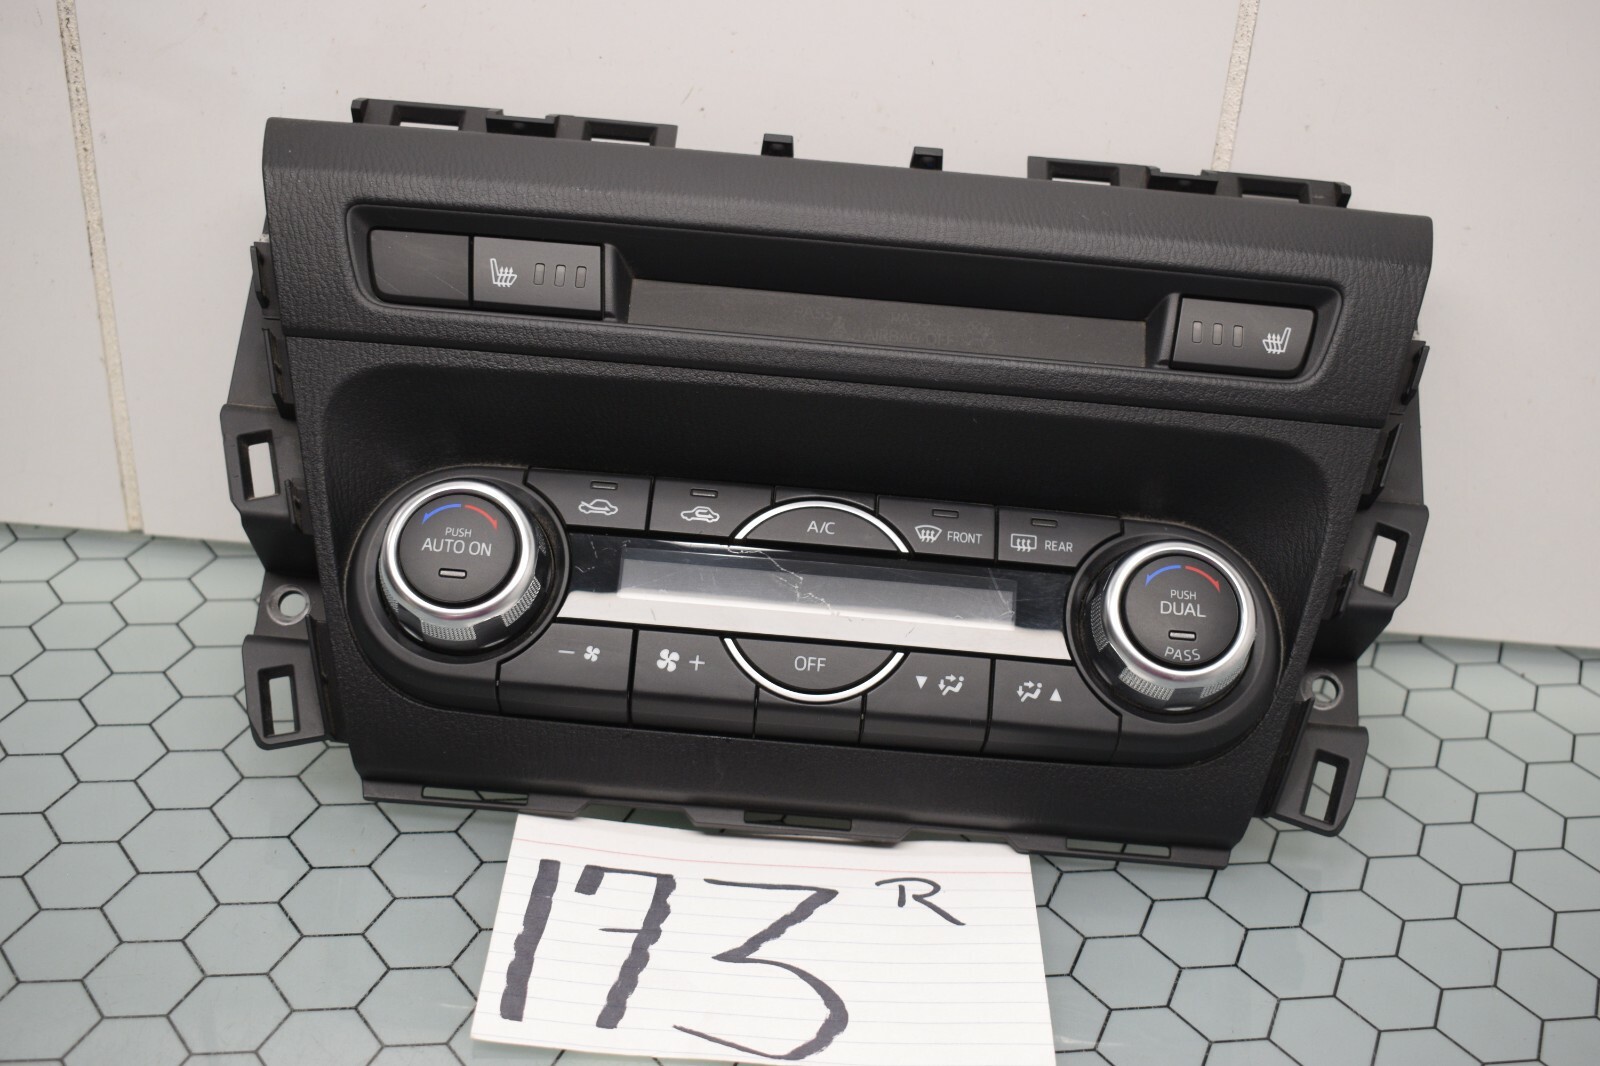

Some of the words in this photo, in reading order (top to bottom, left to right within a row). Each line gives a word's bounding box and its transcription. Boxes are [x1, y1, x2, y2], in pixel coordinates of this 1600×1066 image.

[444, 526, 472, 538] PUSH
[806, 520, 836, 536] A/C
[946, 530, 983, 545] FRONT
[421, 537, 465, 555] AUTO
[468, 540, 493, 557] ON
[1044, 540, 1074, 553] REAR
[1170, 589, 1197, 601] PUSH
[1159, 600, 1207, 618] DUAL
[1164, 646, 1201, 662] PASS
[793, 655, 827, 673] OFF
[875, 876, 967, 927] R
[499, 858, 850, 1061] 173
